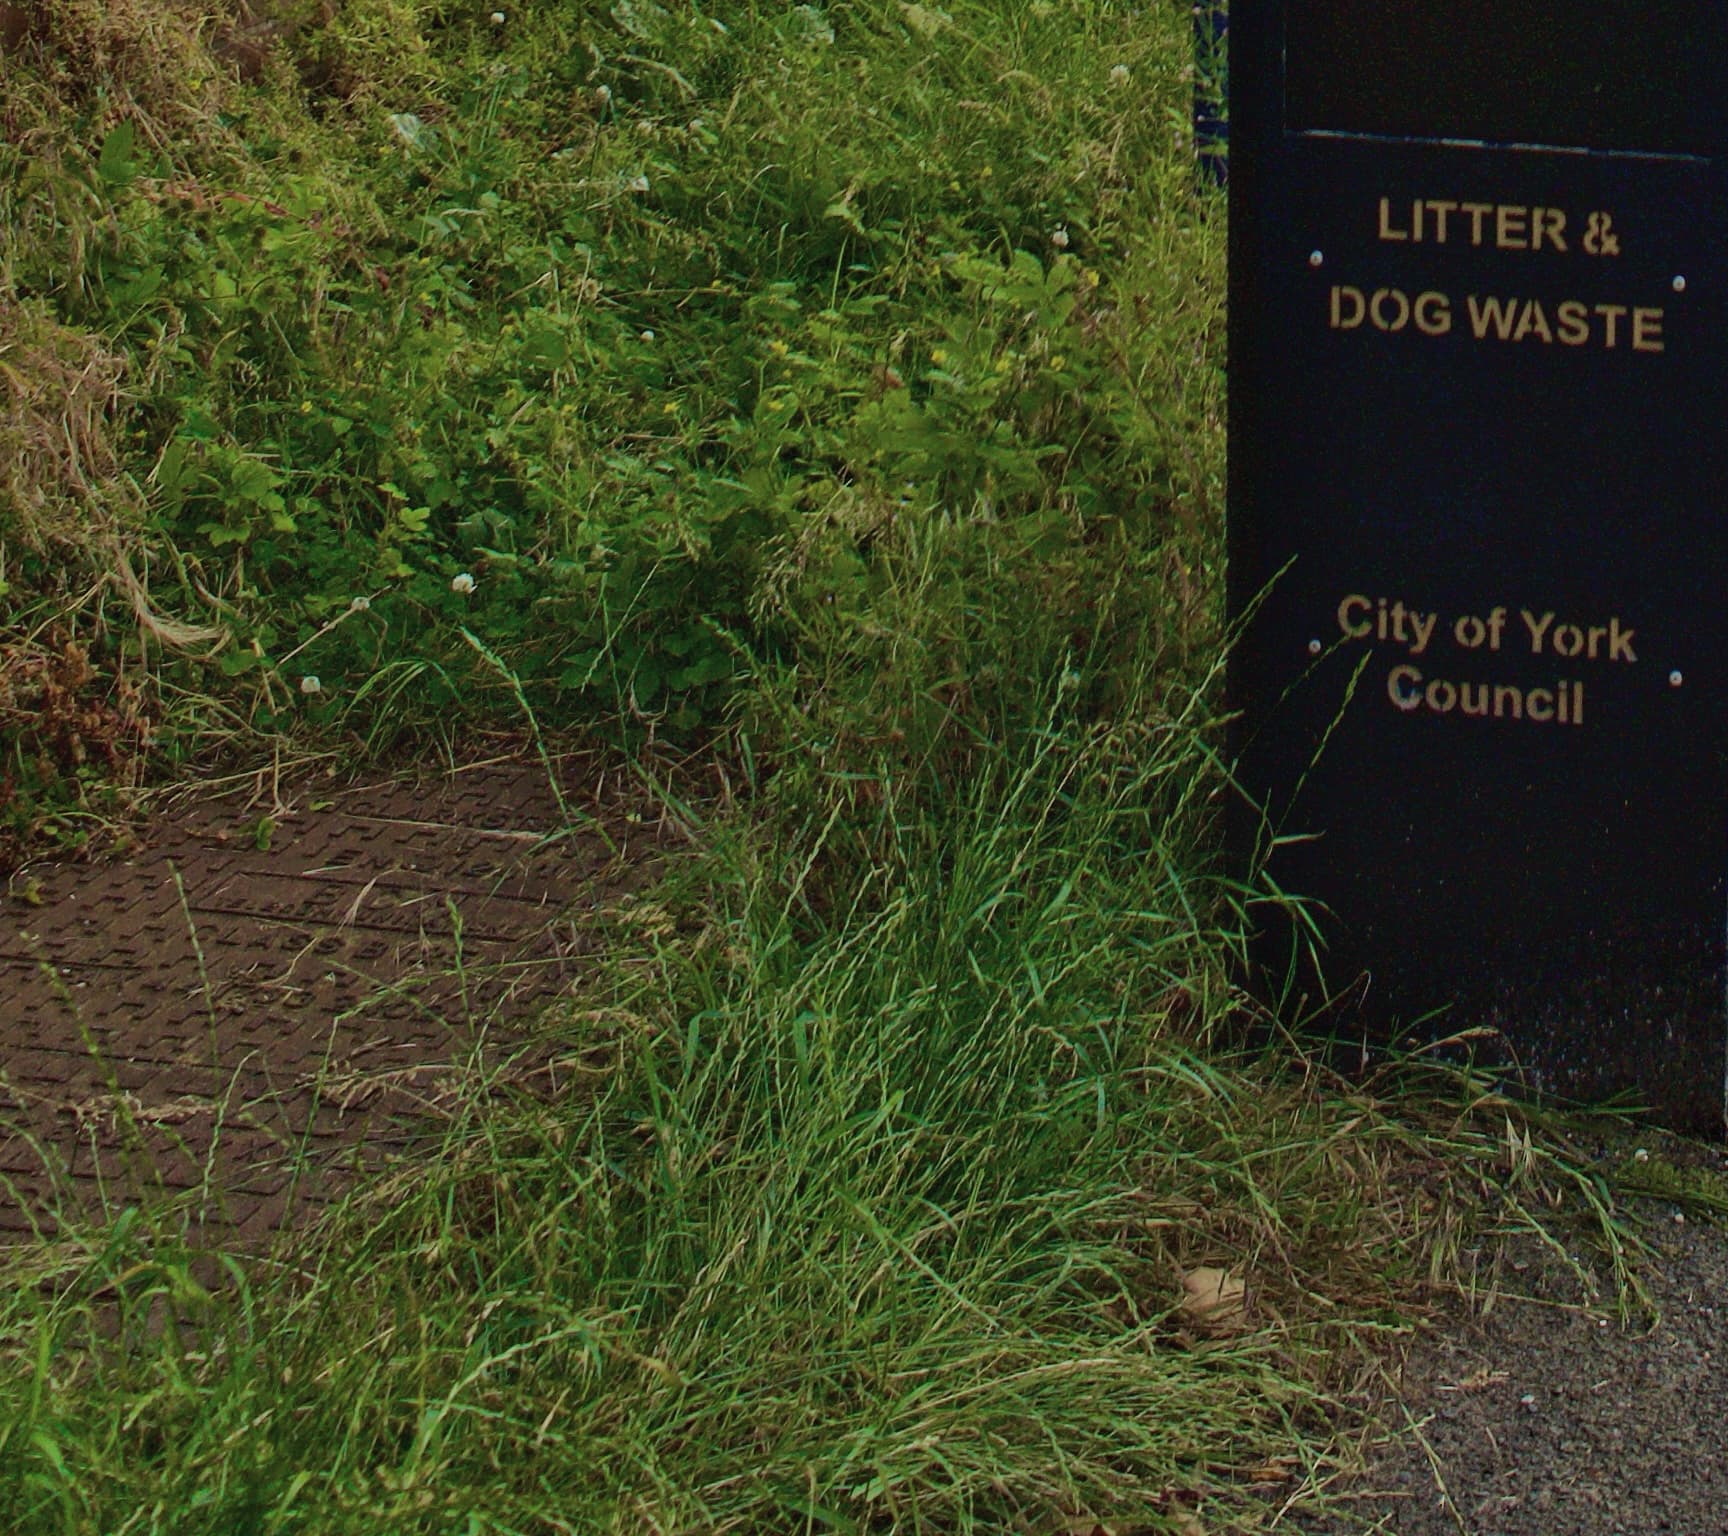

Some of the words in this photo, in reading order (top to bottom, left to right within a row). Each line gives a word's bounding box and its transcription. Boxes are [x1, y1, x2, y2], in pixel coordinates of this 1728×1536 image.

[1378, 196, 1568, 253] LITTER
[1583, 211, 1621, 257] &
[1330, 285, 1452, 336] DOG
[1468, 294, 1665, 353] WASTE
[1338, 594, 1437, 655] City
[1455, 607, 1506, 650] of
[1521, 609, 1639, 663] York
[1387, 665, 1585, 726] Council
